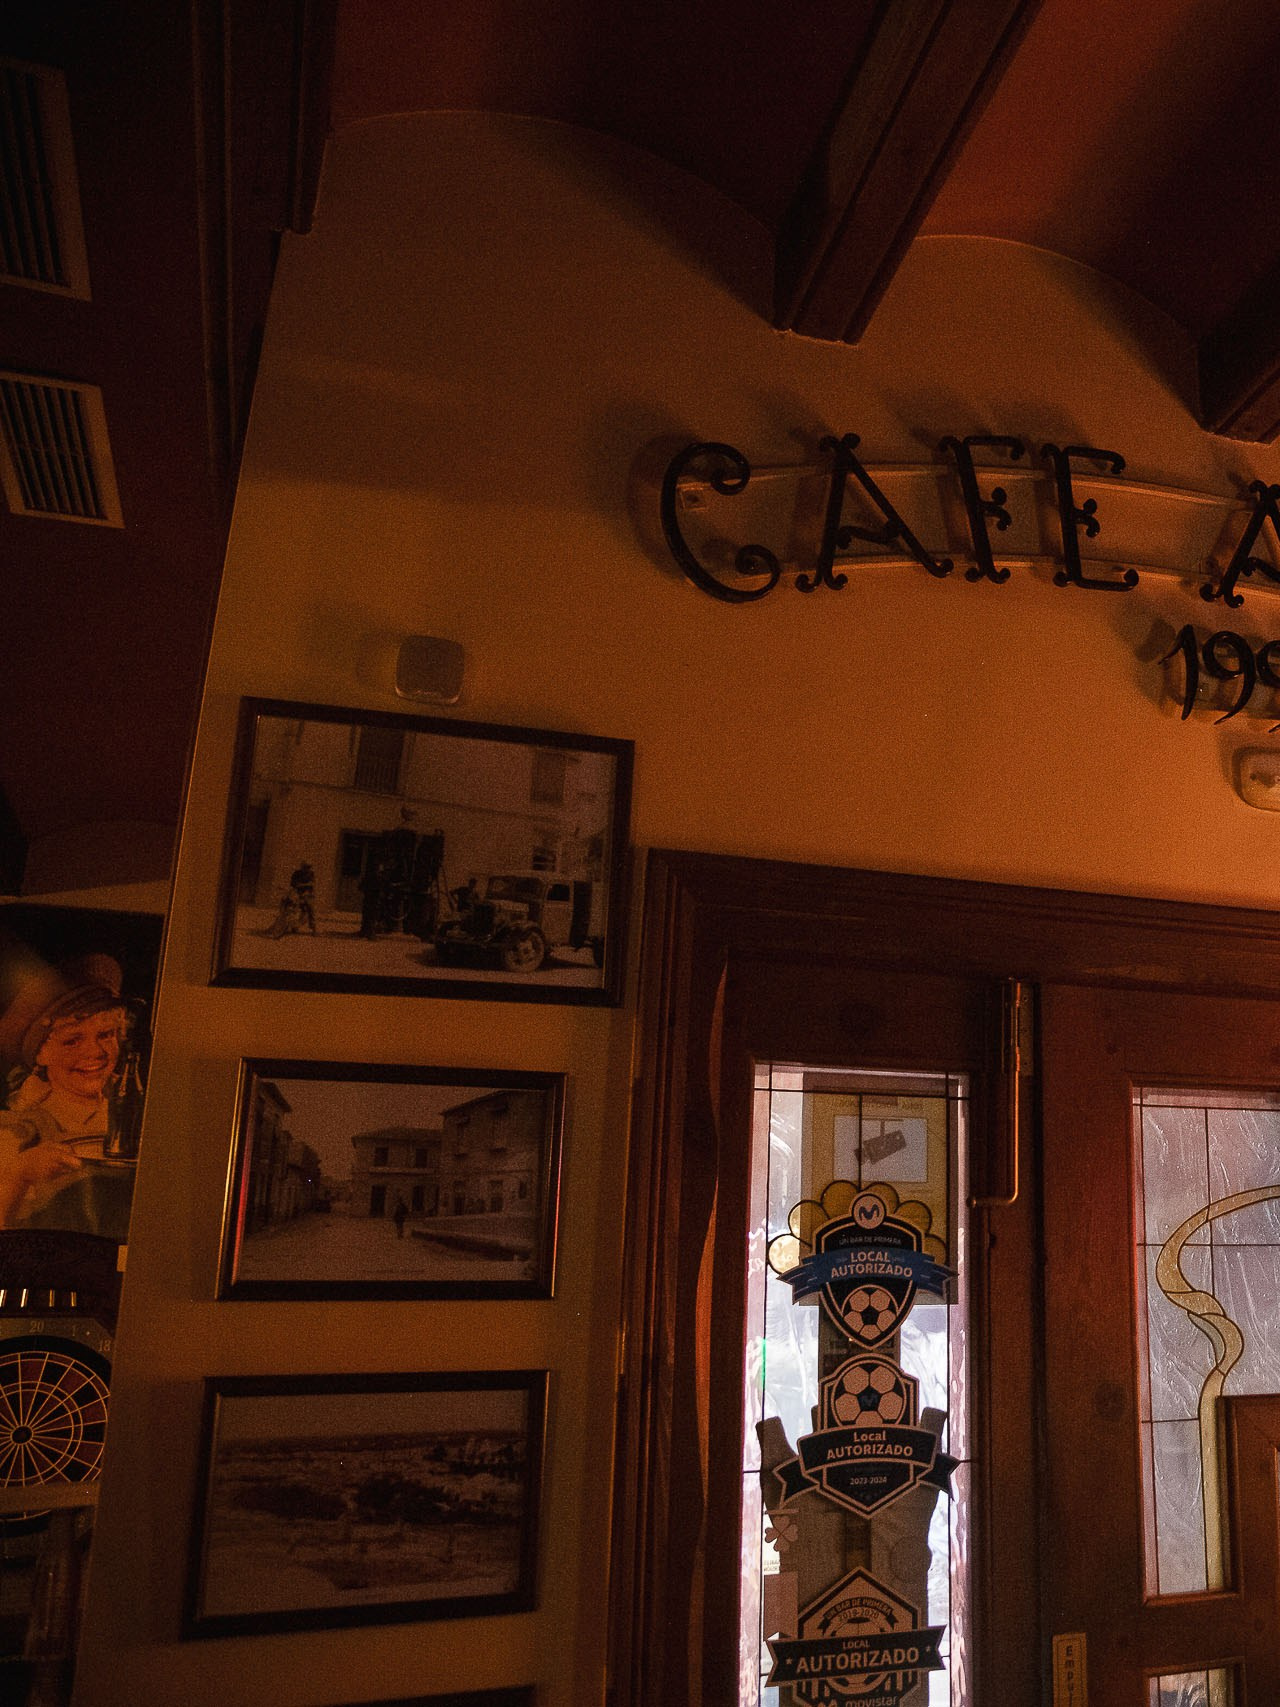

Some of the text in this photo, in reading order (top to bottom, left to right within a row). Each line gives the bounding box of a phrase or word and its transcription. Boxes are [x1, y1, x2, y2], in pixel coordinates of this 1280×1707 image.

[661, 433, 1139, 602] CAFE
[850, 1250, 890, 1263] LOCAL
[831, 1262, 913, 1278] AUTORIZADO
[853, 1430, 887, 1442] Local
[826, 1443, 913, 1460] AUTORIZADO
[842, 1640, 870, 1650] LOCAL
[796, 1647, 919, 1674] AUTORIZADO
